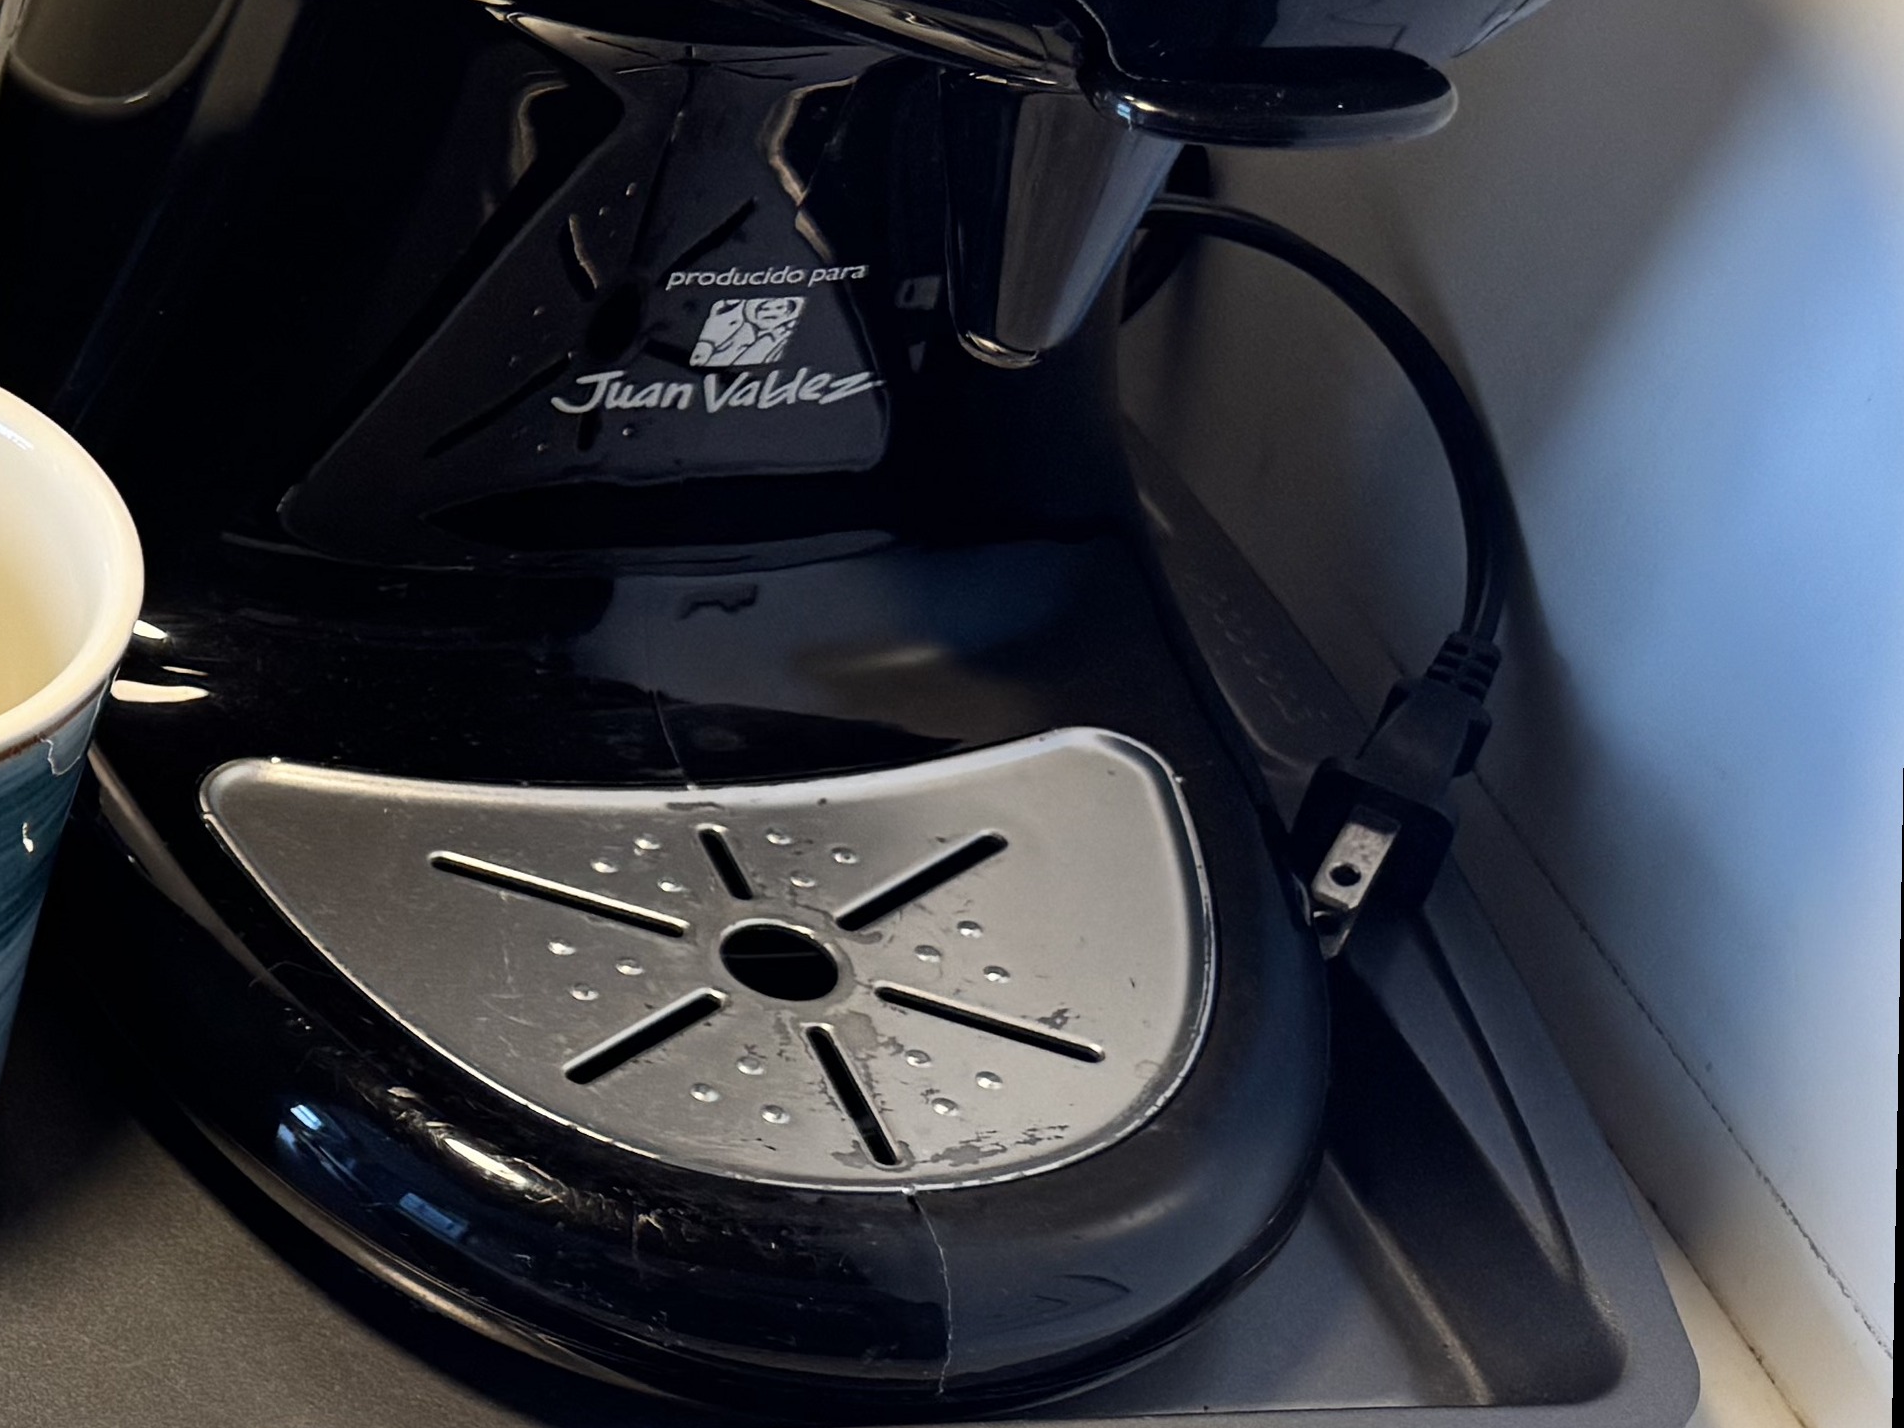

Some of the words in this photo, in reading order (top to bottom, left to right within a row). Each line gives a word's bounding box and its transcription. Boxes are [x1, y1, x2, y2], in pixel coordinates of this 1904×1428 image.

[665, 266, 804, 291] producido
[808, 265, 870, 287] para
[551, 370, 693, 413] Juan
[703, 367, 884, 413] Valdez
